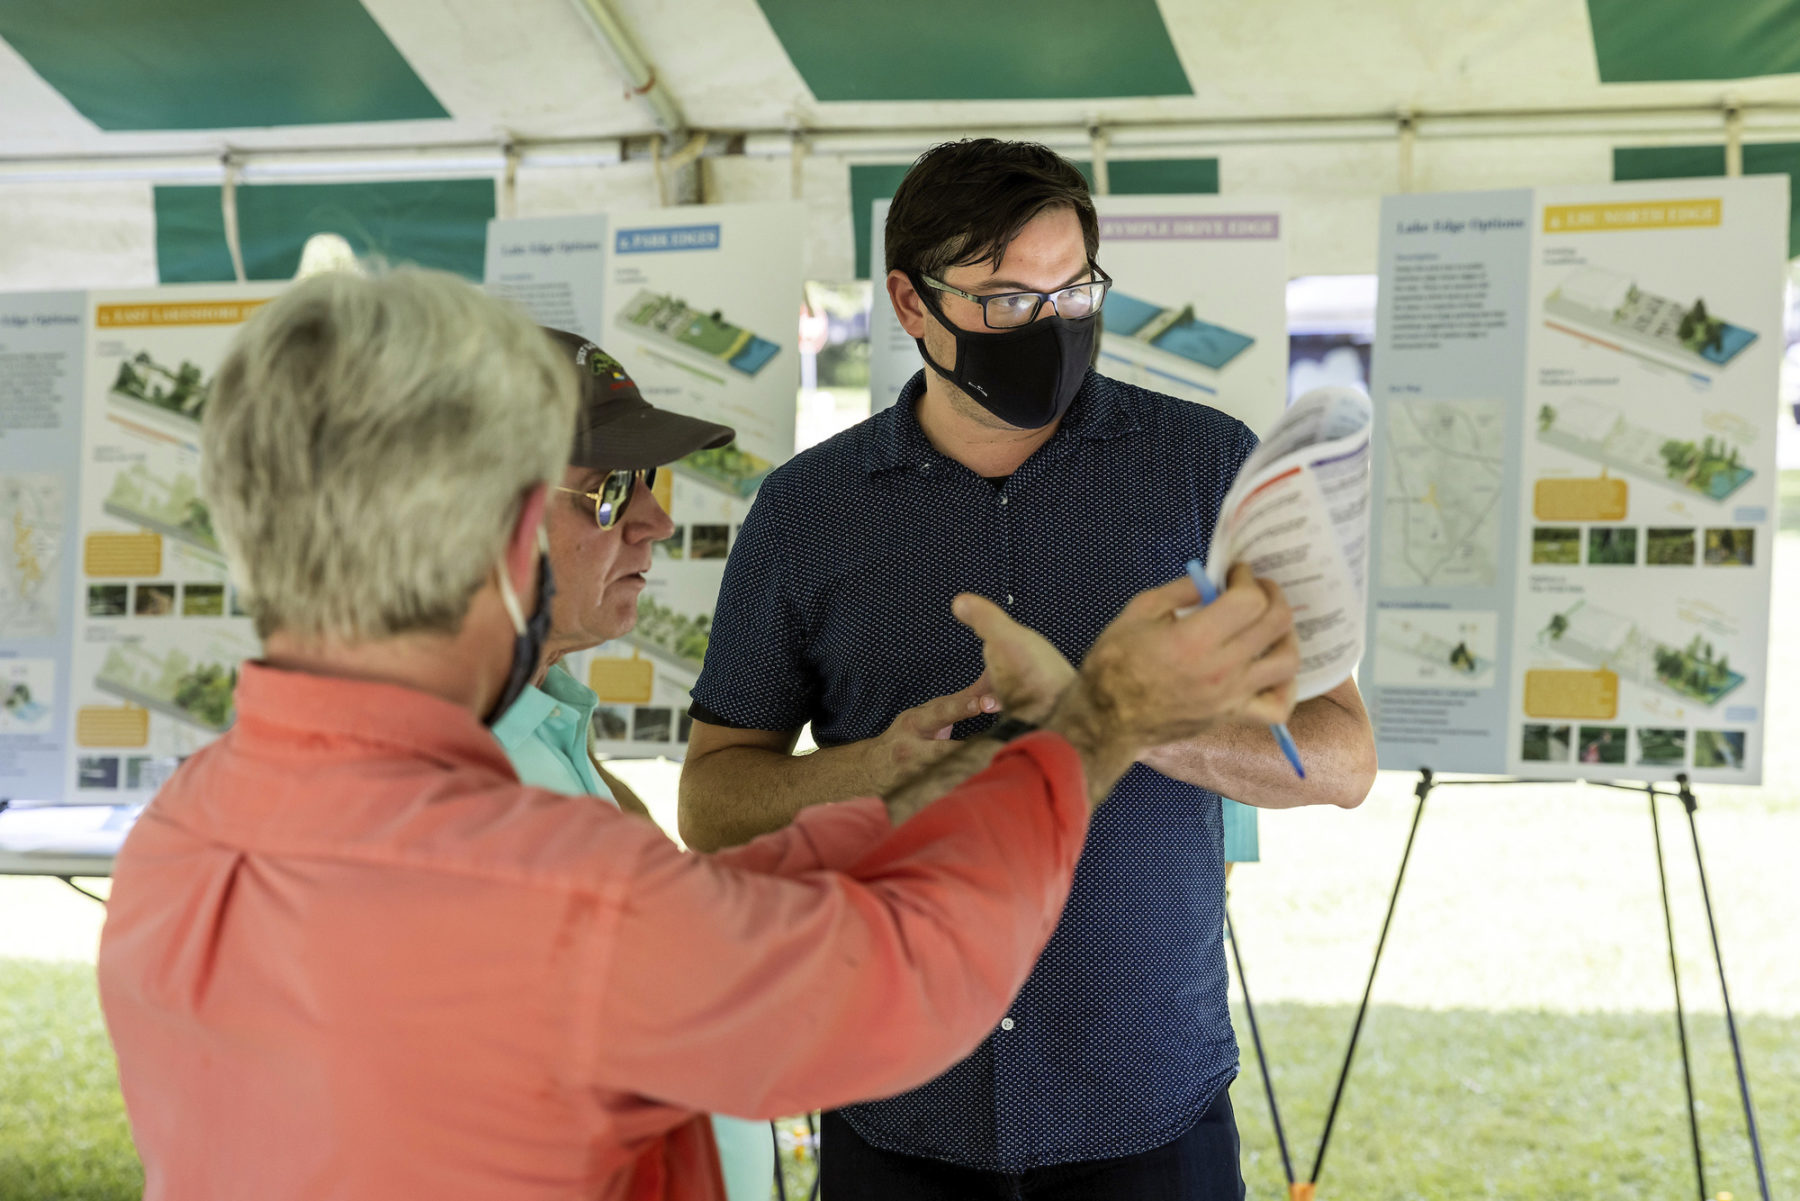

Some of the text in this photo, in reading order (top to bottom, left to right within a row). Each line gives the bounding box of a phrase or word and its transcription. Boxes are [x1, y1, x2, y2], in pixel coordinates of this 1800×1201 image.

[1603, 207, 1665, 225] NORTH
[1667, 205, 1715, 222] EDGE
[1172, 219, 1224, 236] DRIVE
[1227, 219, 1273, 235] EDGE
[1396, 217, 1525, 235] Lake Edge Options
[633, 232, 669, 248] PARK
